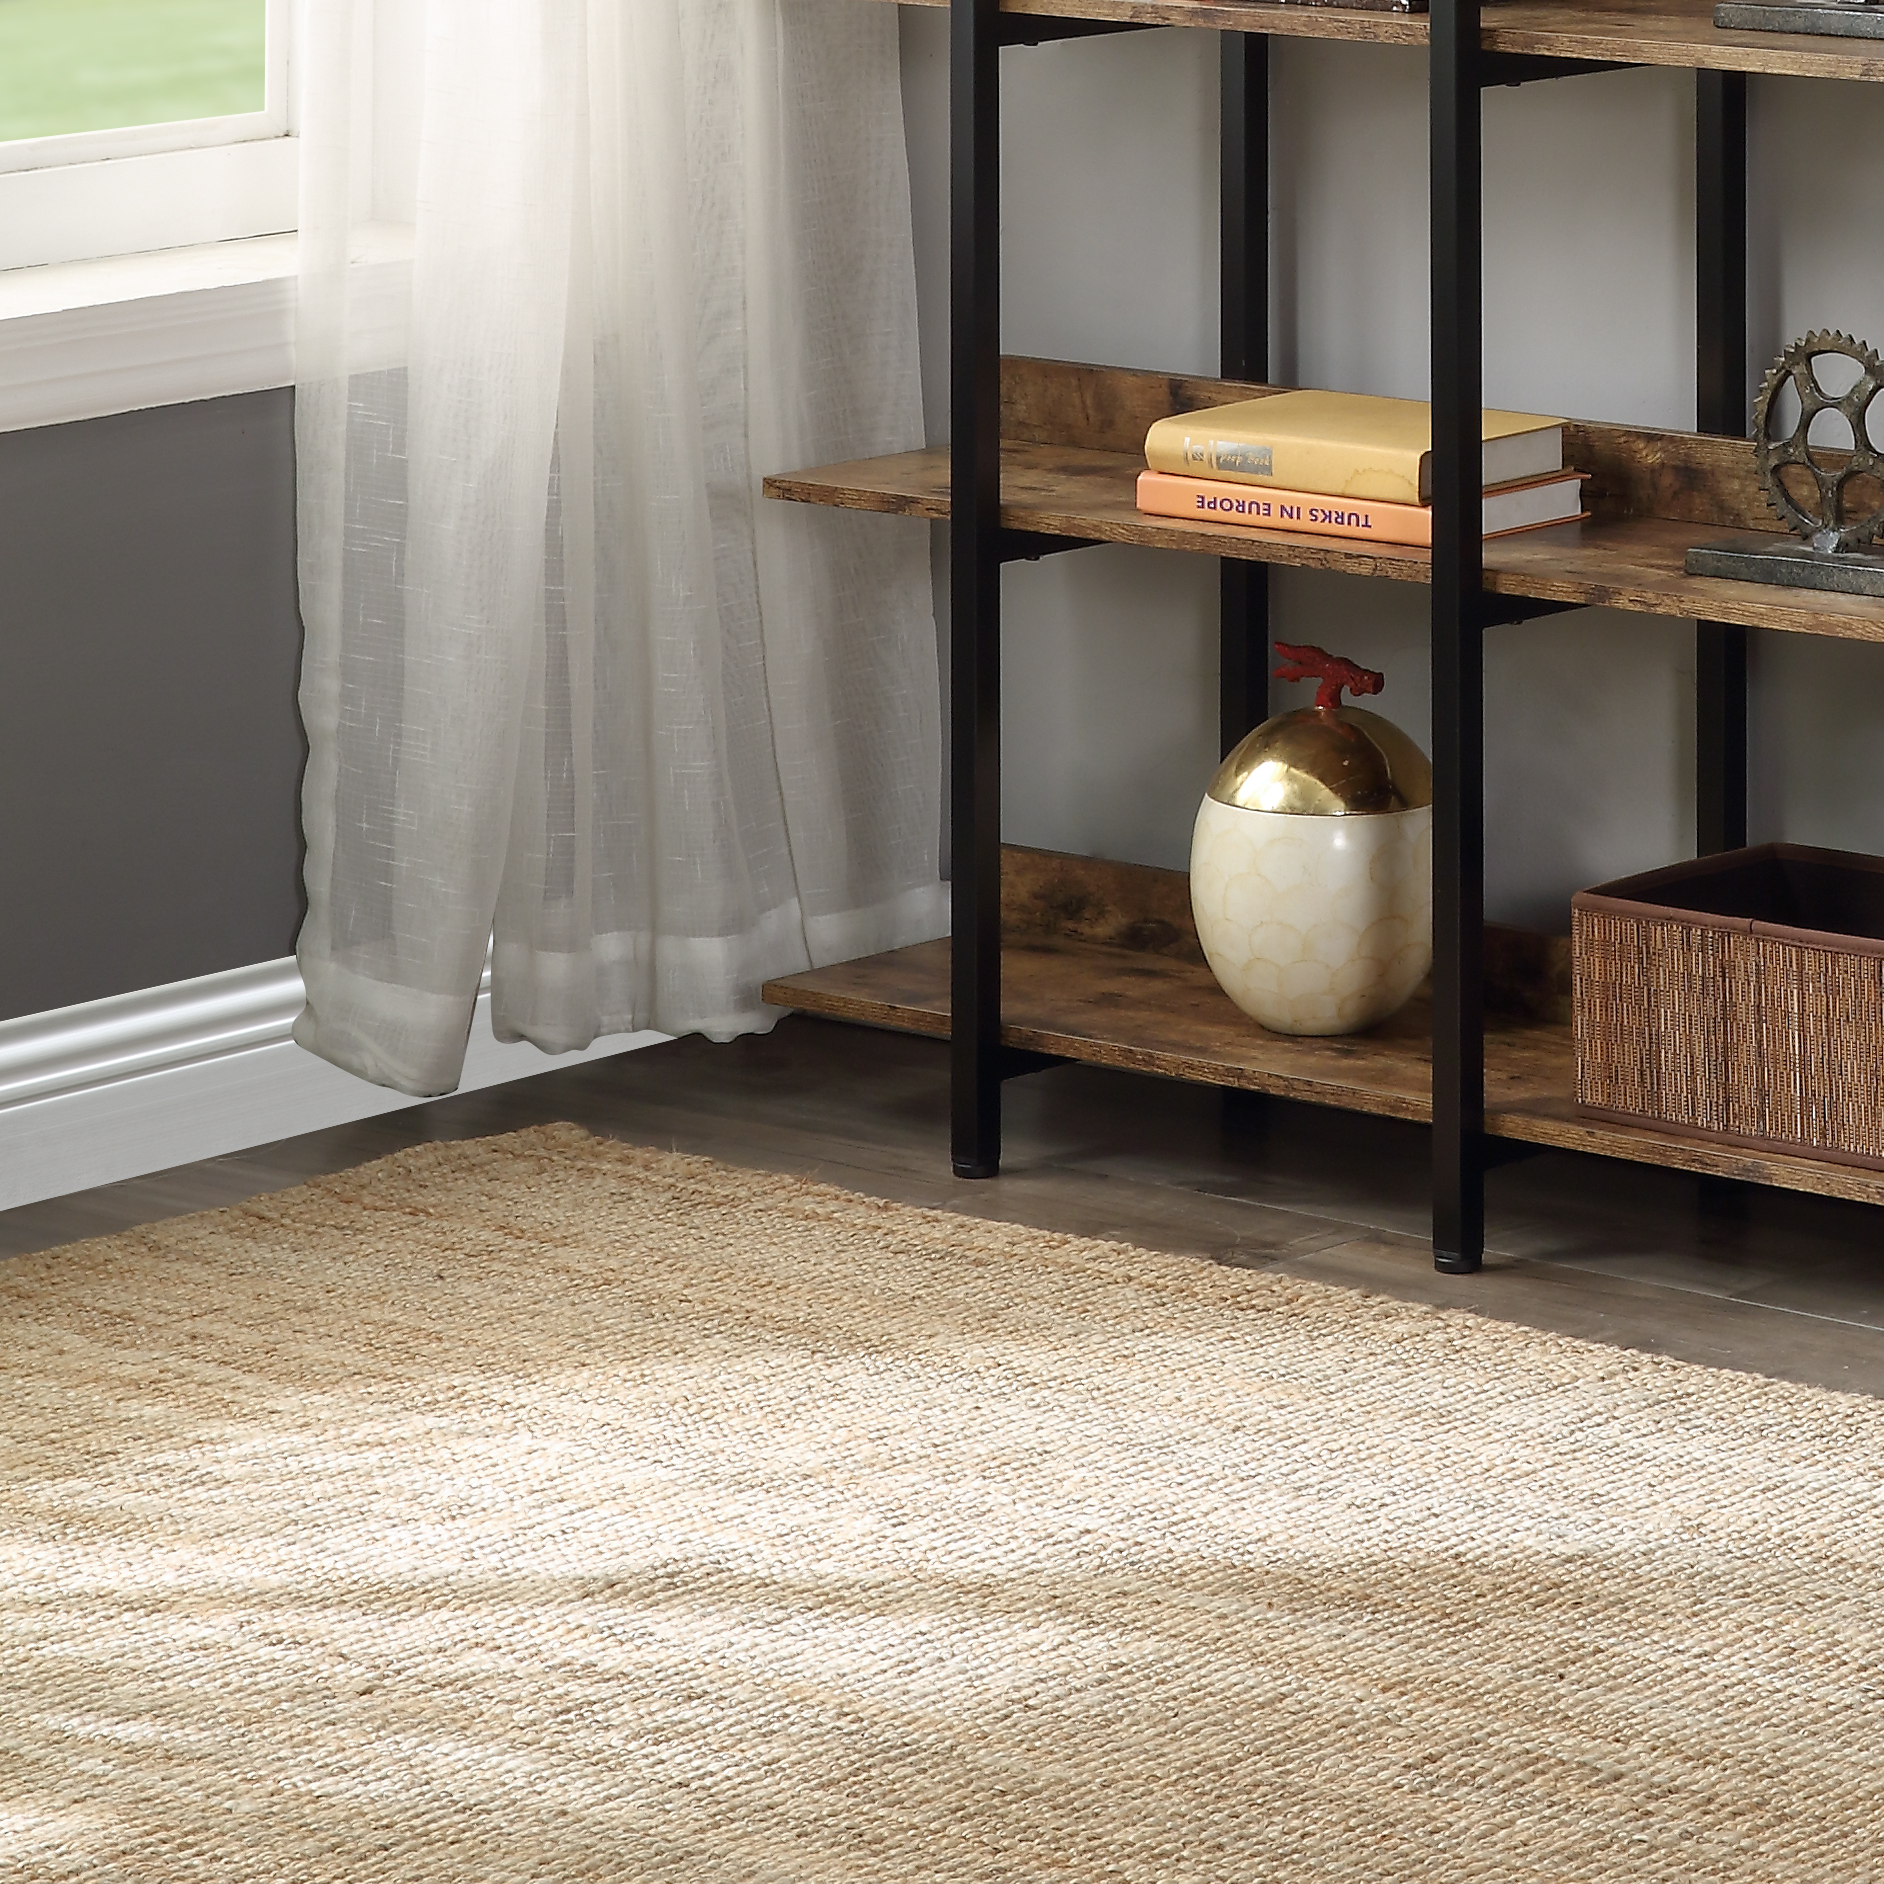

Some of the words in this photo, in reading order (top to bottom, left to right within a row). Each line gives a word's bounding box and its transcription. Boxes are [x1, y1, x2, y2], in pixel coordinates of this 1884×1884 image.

[1196, 495, 1271, 517] EUROPE
[1280, 504, 1301, 520] IN
[1308, 508, 1372, 529] TURKS
